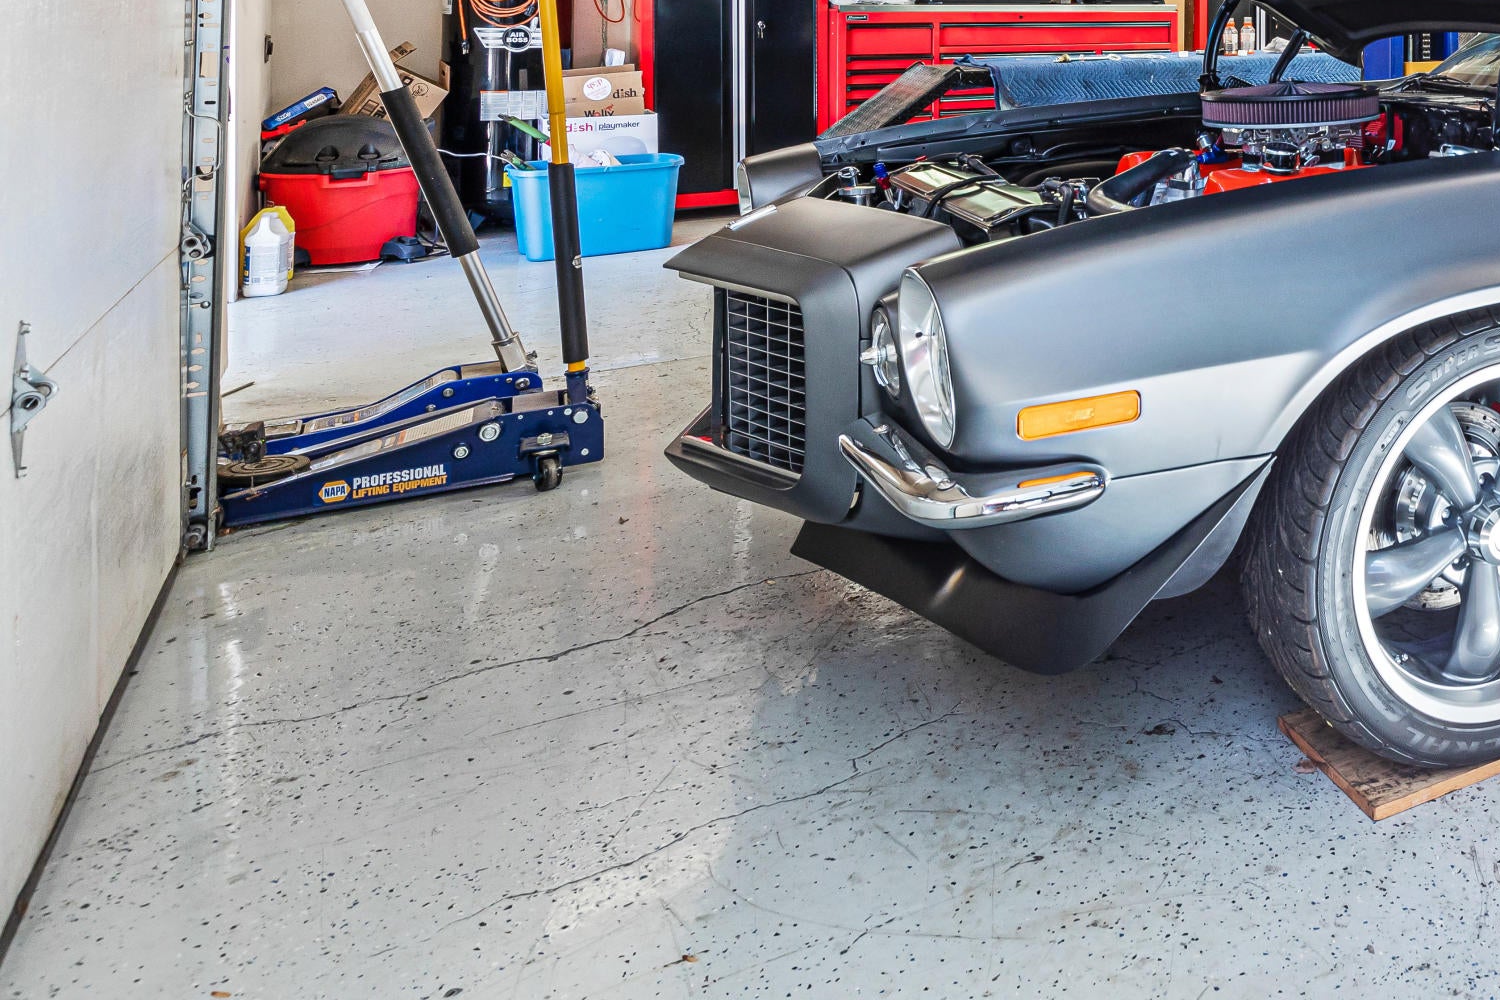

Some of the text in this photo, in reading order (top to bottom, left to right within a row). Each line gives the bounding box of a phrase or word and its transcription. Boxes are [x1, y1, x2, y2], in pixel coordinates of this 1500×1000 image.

[613, 88, 637, 99] dish
[566, 121, 640, 132] dish playmaker
[1406, 345, 1480, 406] SUPER
[353, 464, 447, 489] PROFESSIONAL
[324, 485, 347, 498] NAPA
[352, 475, 447, 499] LIFTING EQUIPMENT
